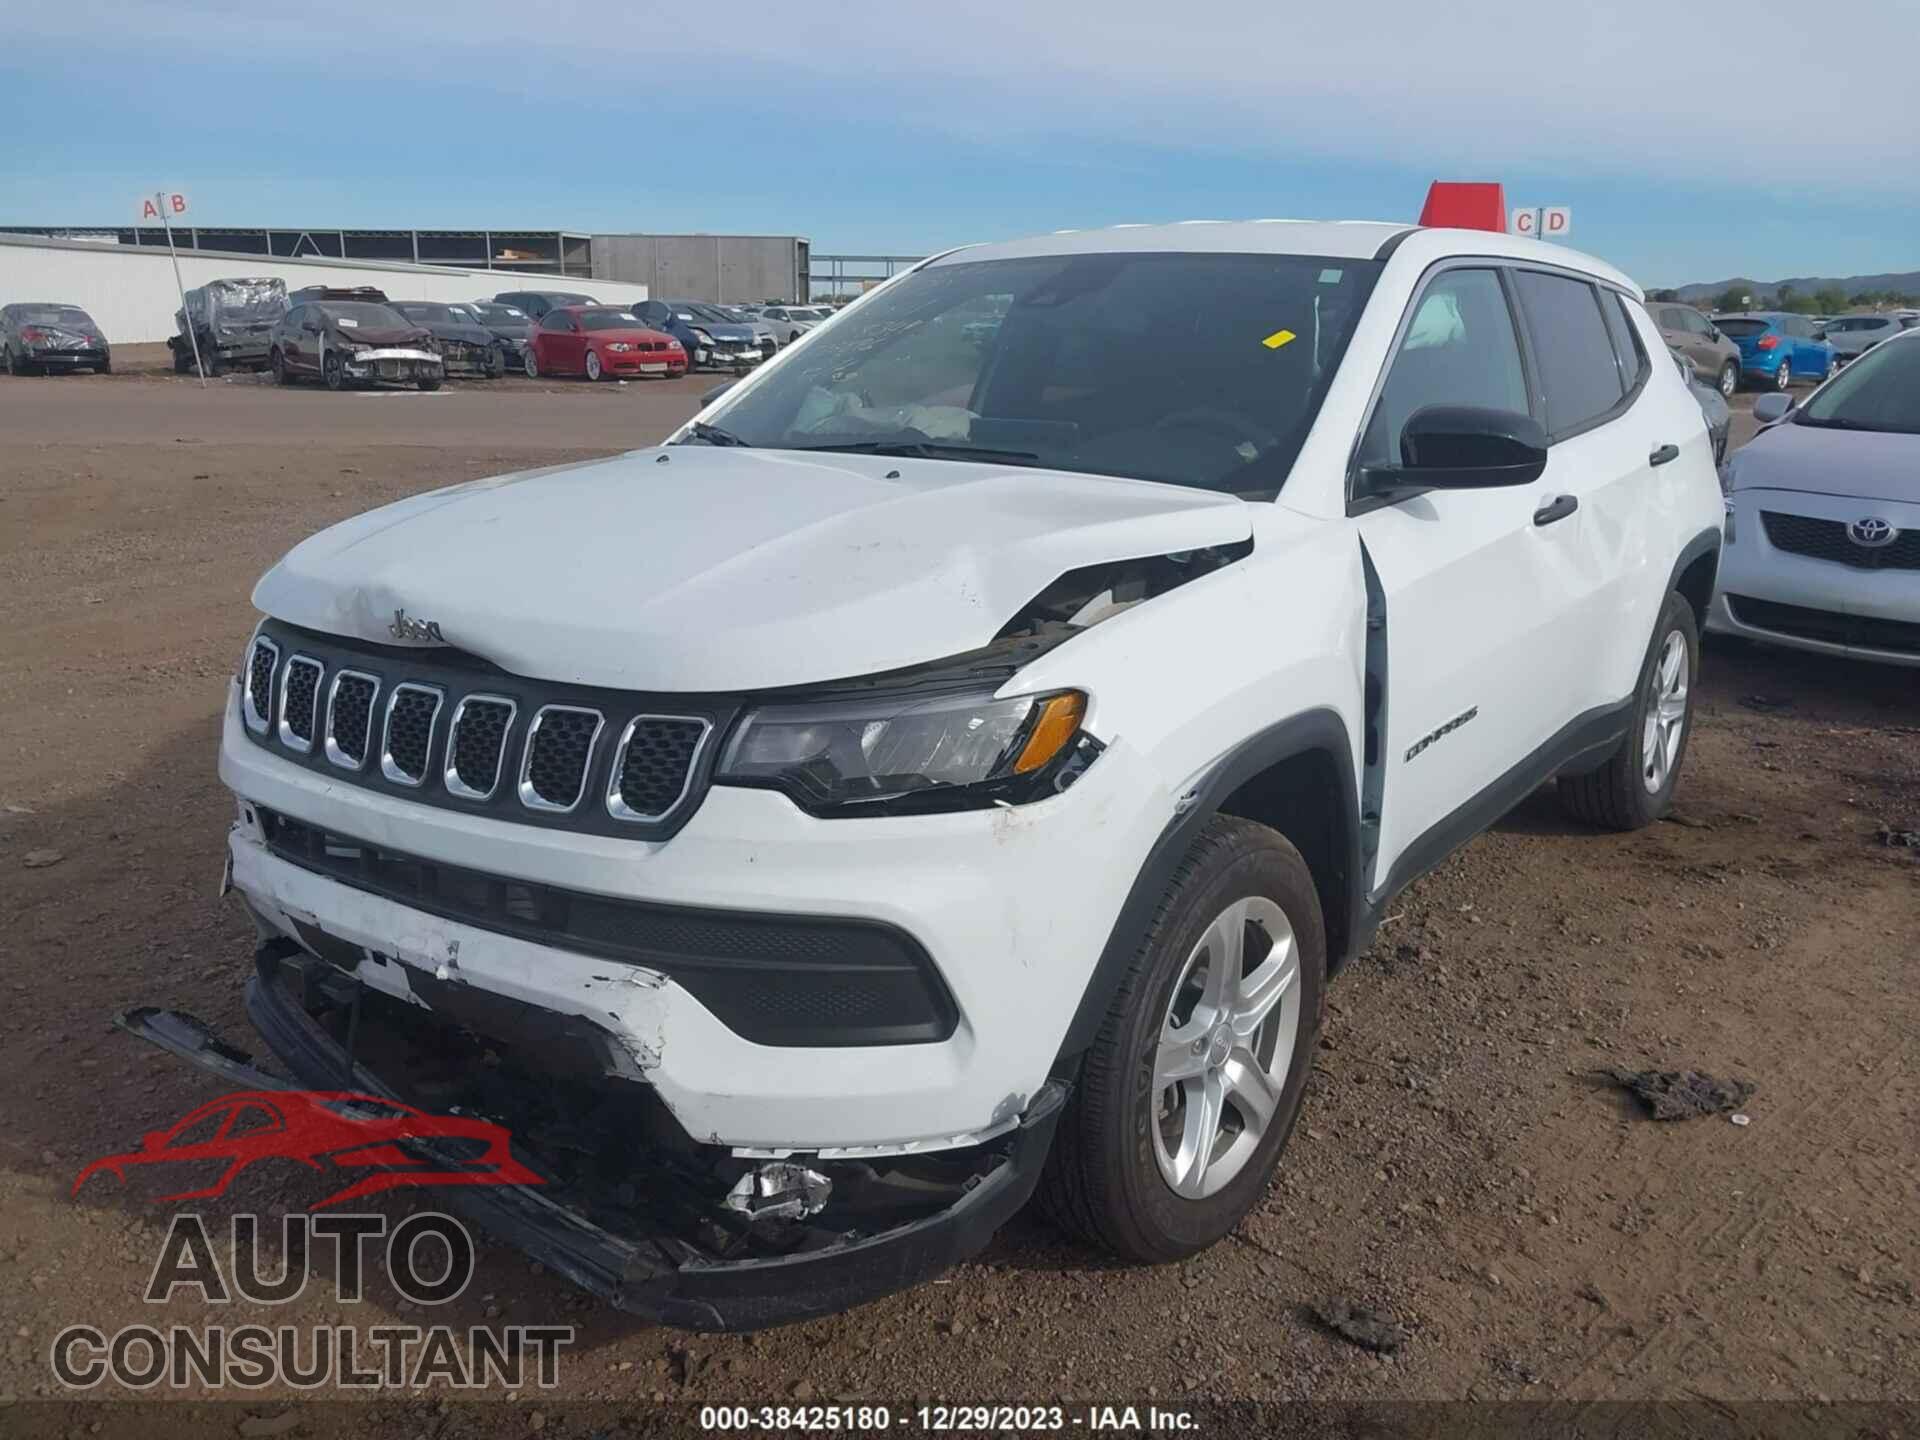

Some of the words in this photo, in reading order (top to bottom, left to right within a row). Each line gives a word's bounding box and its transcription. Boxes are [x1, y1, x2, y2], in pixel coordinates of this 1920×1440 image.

[143, 200, 157, 218] A
[172, 194, 186, 213] B
[1518, 213, 1532, 231] C
[1549, 212, 1565, 230] D
